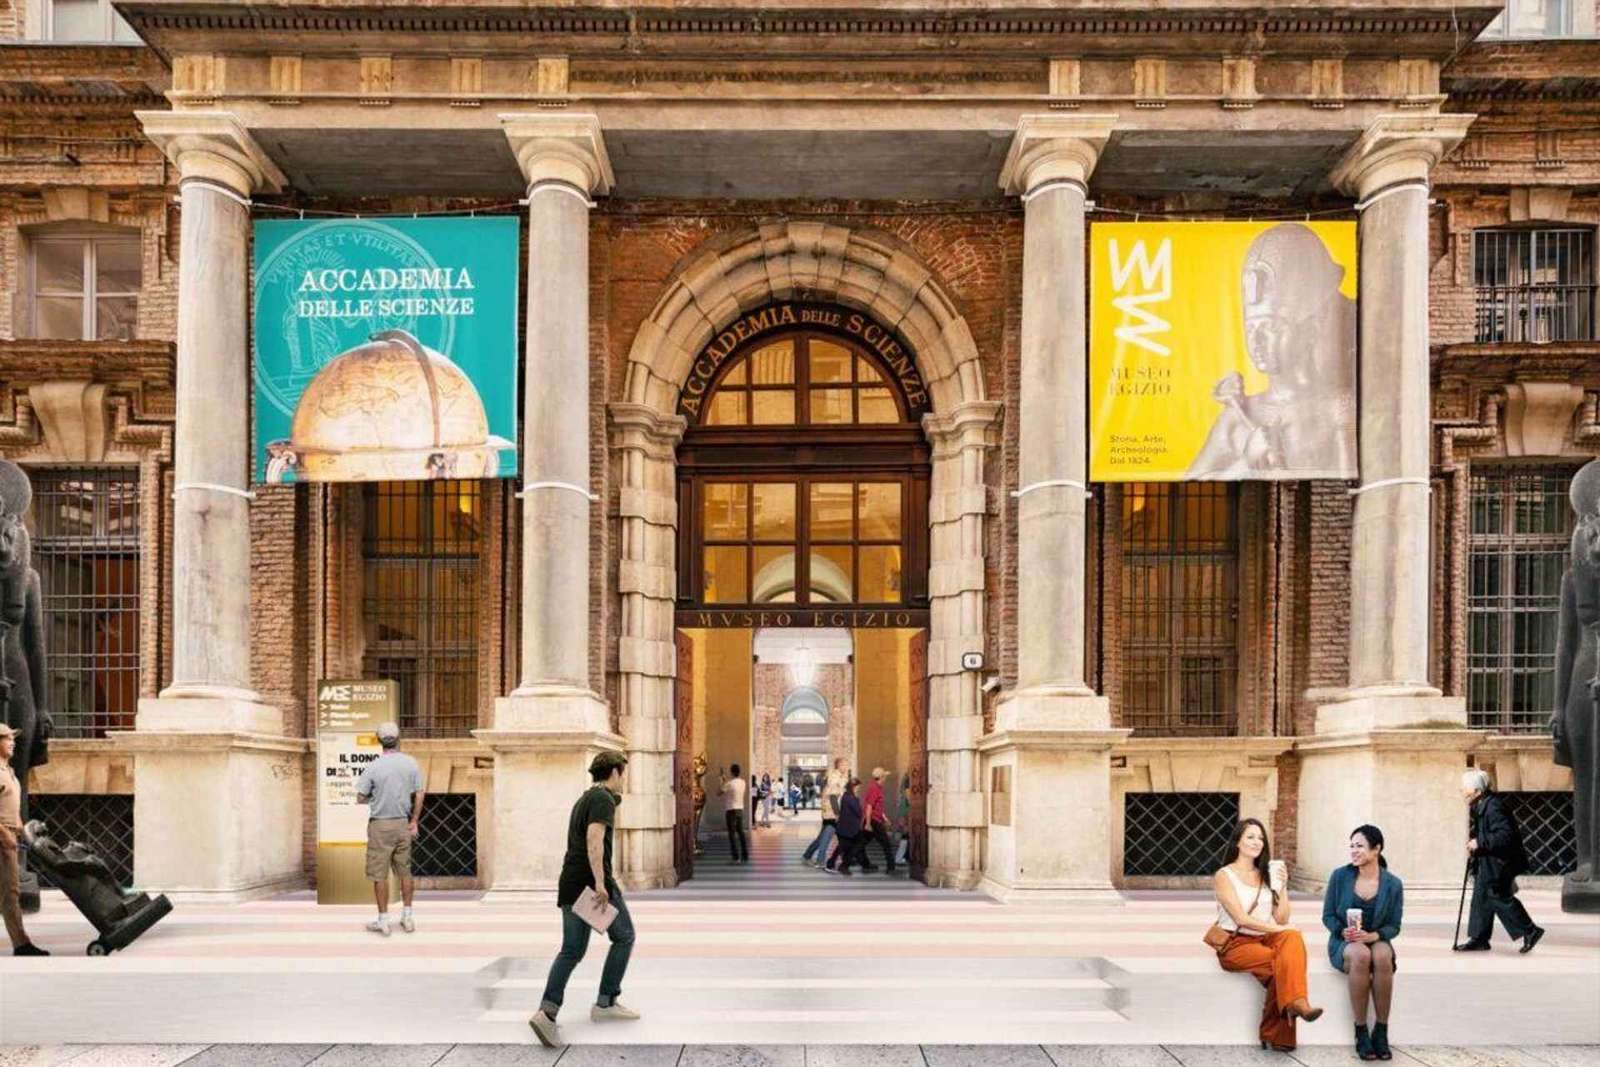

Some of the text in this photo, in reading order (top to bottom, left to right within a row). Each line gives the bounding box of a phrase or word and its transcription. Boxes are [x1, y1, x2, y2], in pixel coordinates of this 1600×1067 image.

[298, 267, 474, 292] ACCADEMIA
[299, 298, 474, 317] DELLE SCIENZE
[682, 305, 927, 417] ACCADEMIA DELLE SCIENZE
[699, 612, 911, 627] MVSEO EGIZIO
[340, 753, 349, 763] IL
[326, 767, 337, 777] DI
